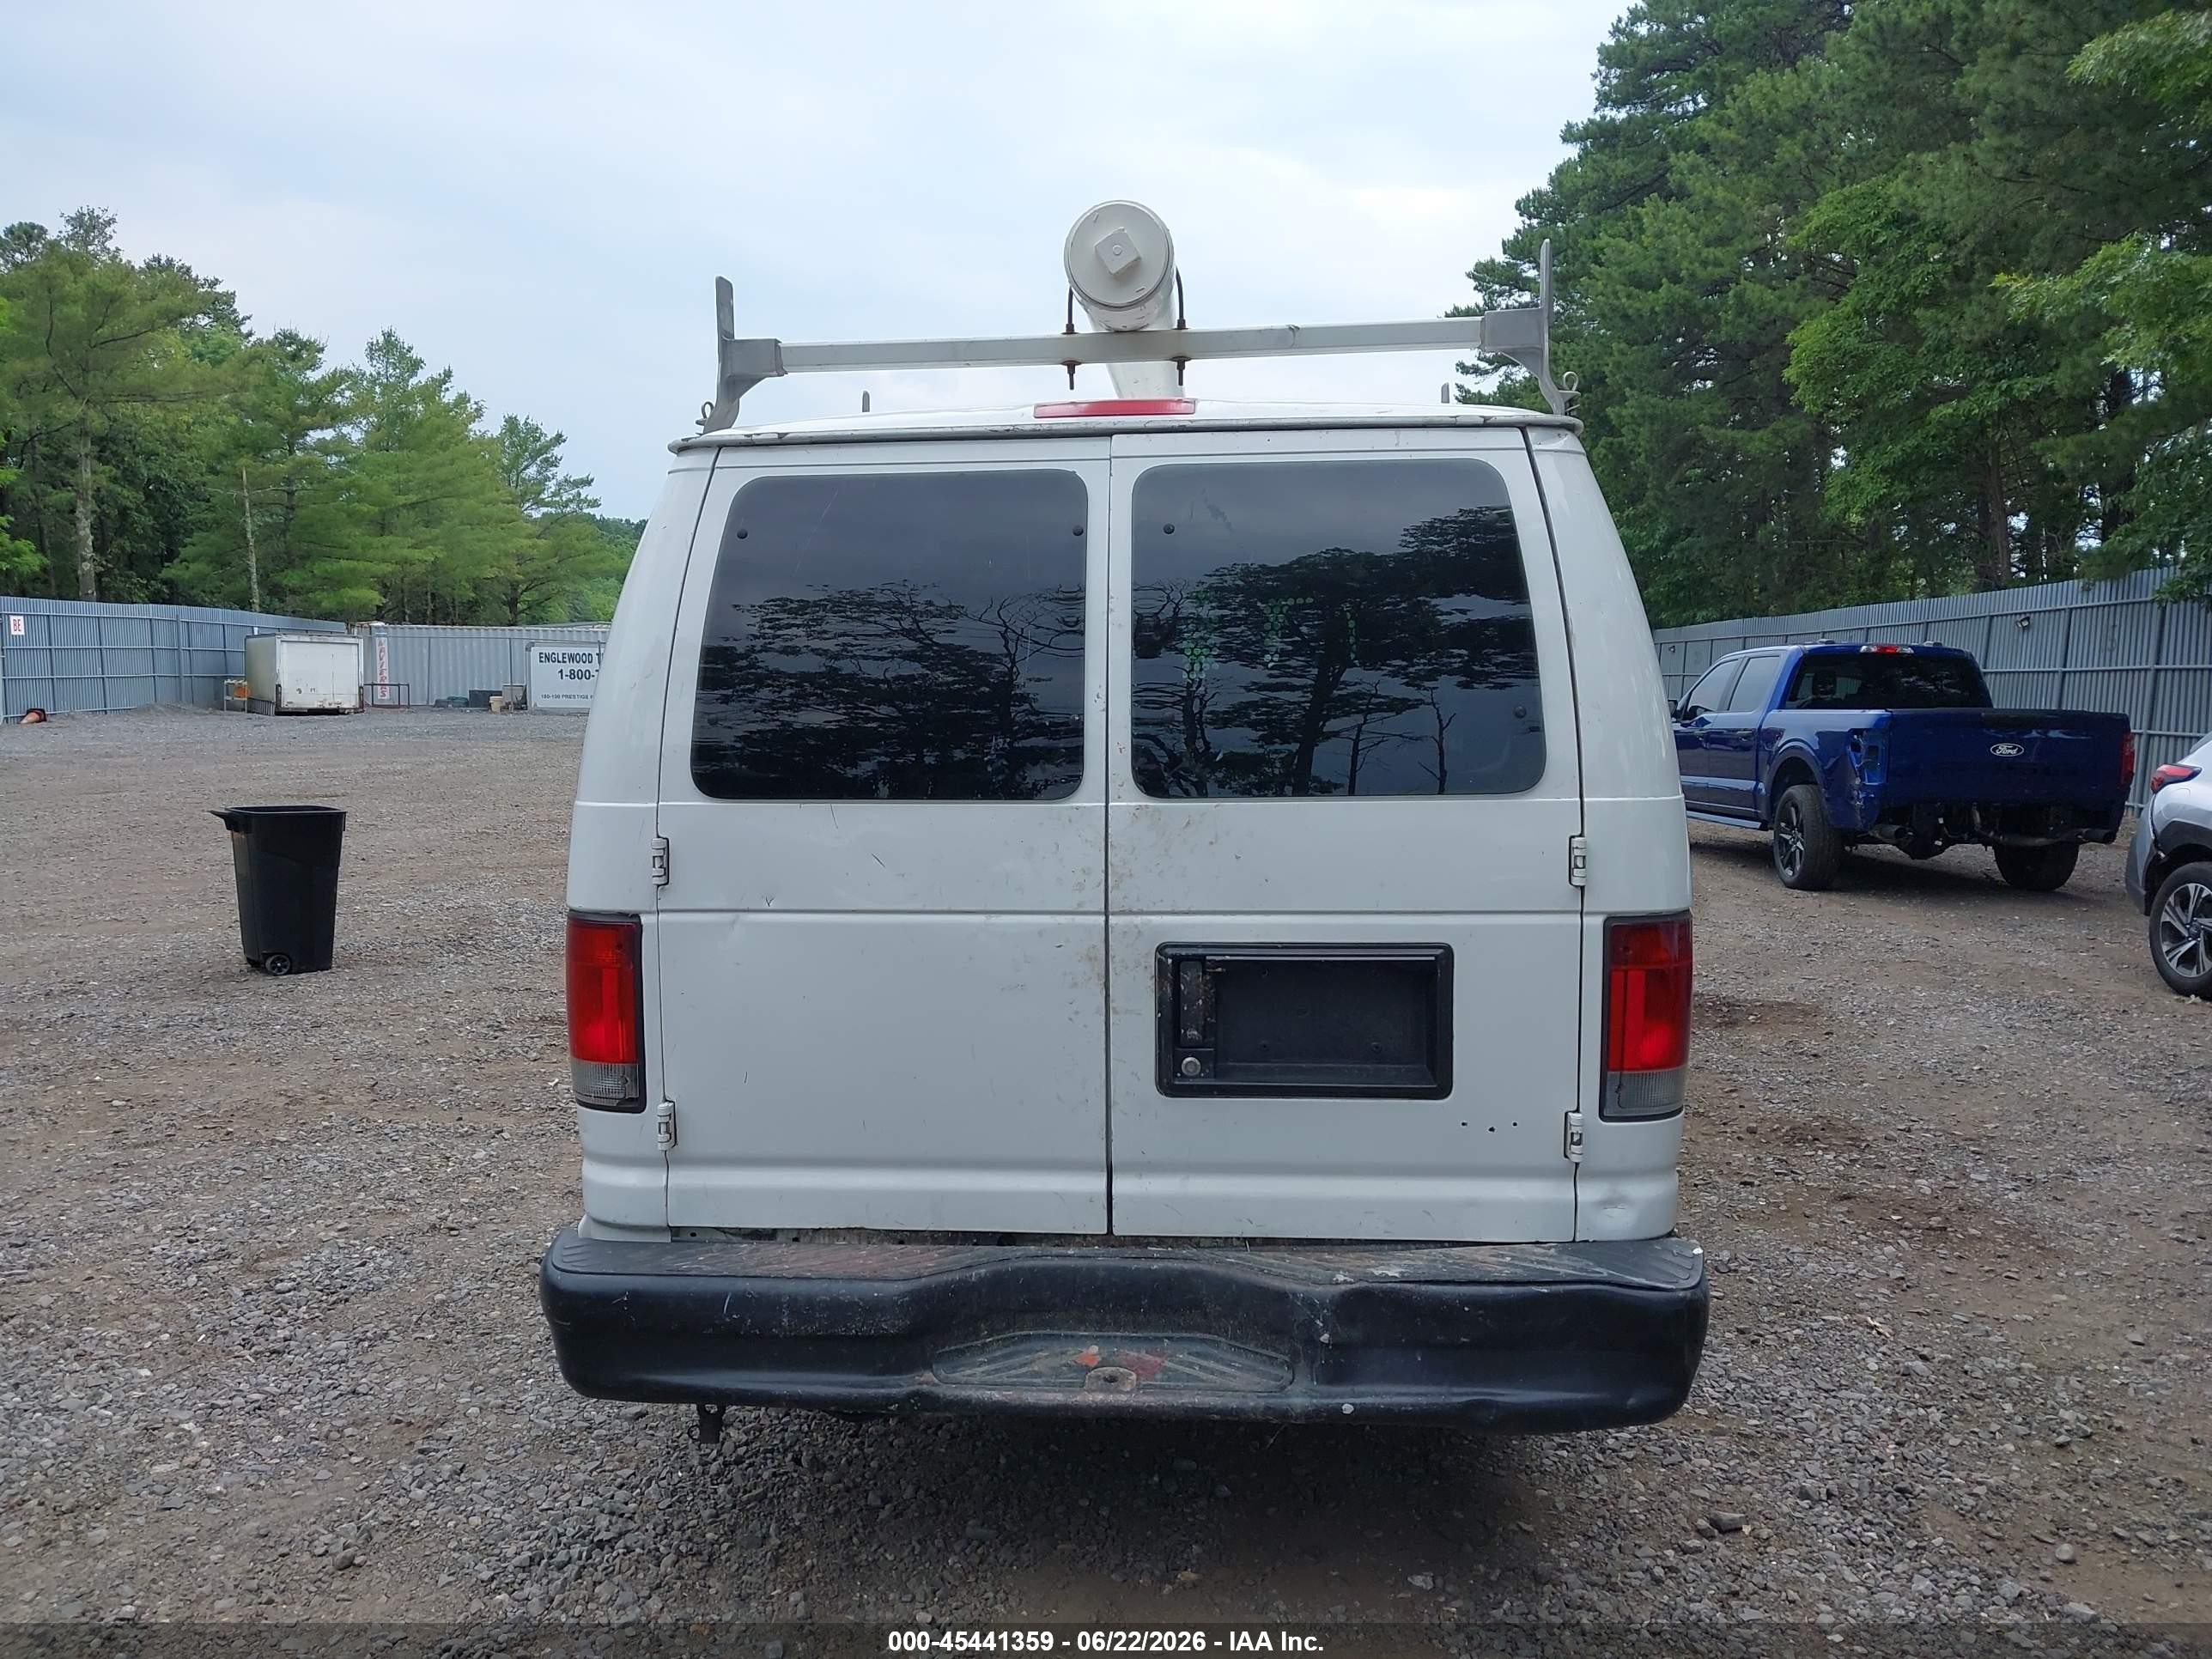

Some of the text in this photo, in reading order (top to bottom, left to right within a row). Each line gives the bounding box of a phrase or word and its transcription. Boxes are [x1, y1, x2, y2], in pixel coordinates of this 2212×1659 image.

[13, 618, 21, 631] BE
[538, 652, 593, 664] ENGLEWOOD
[1996, 744, 2019, 755] Ford
